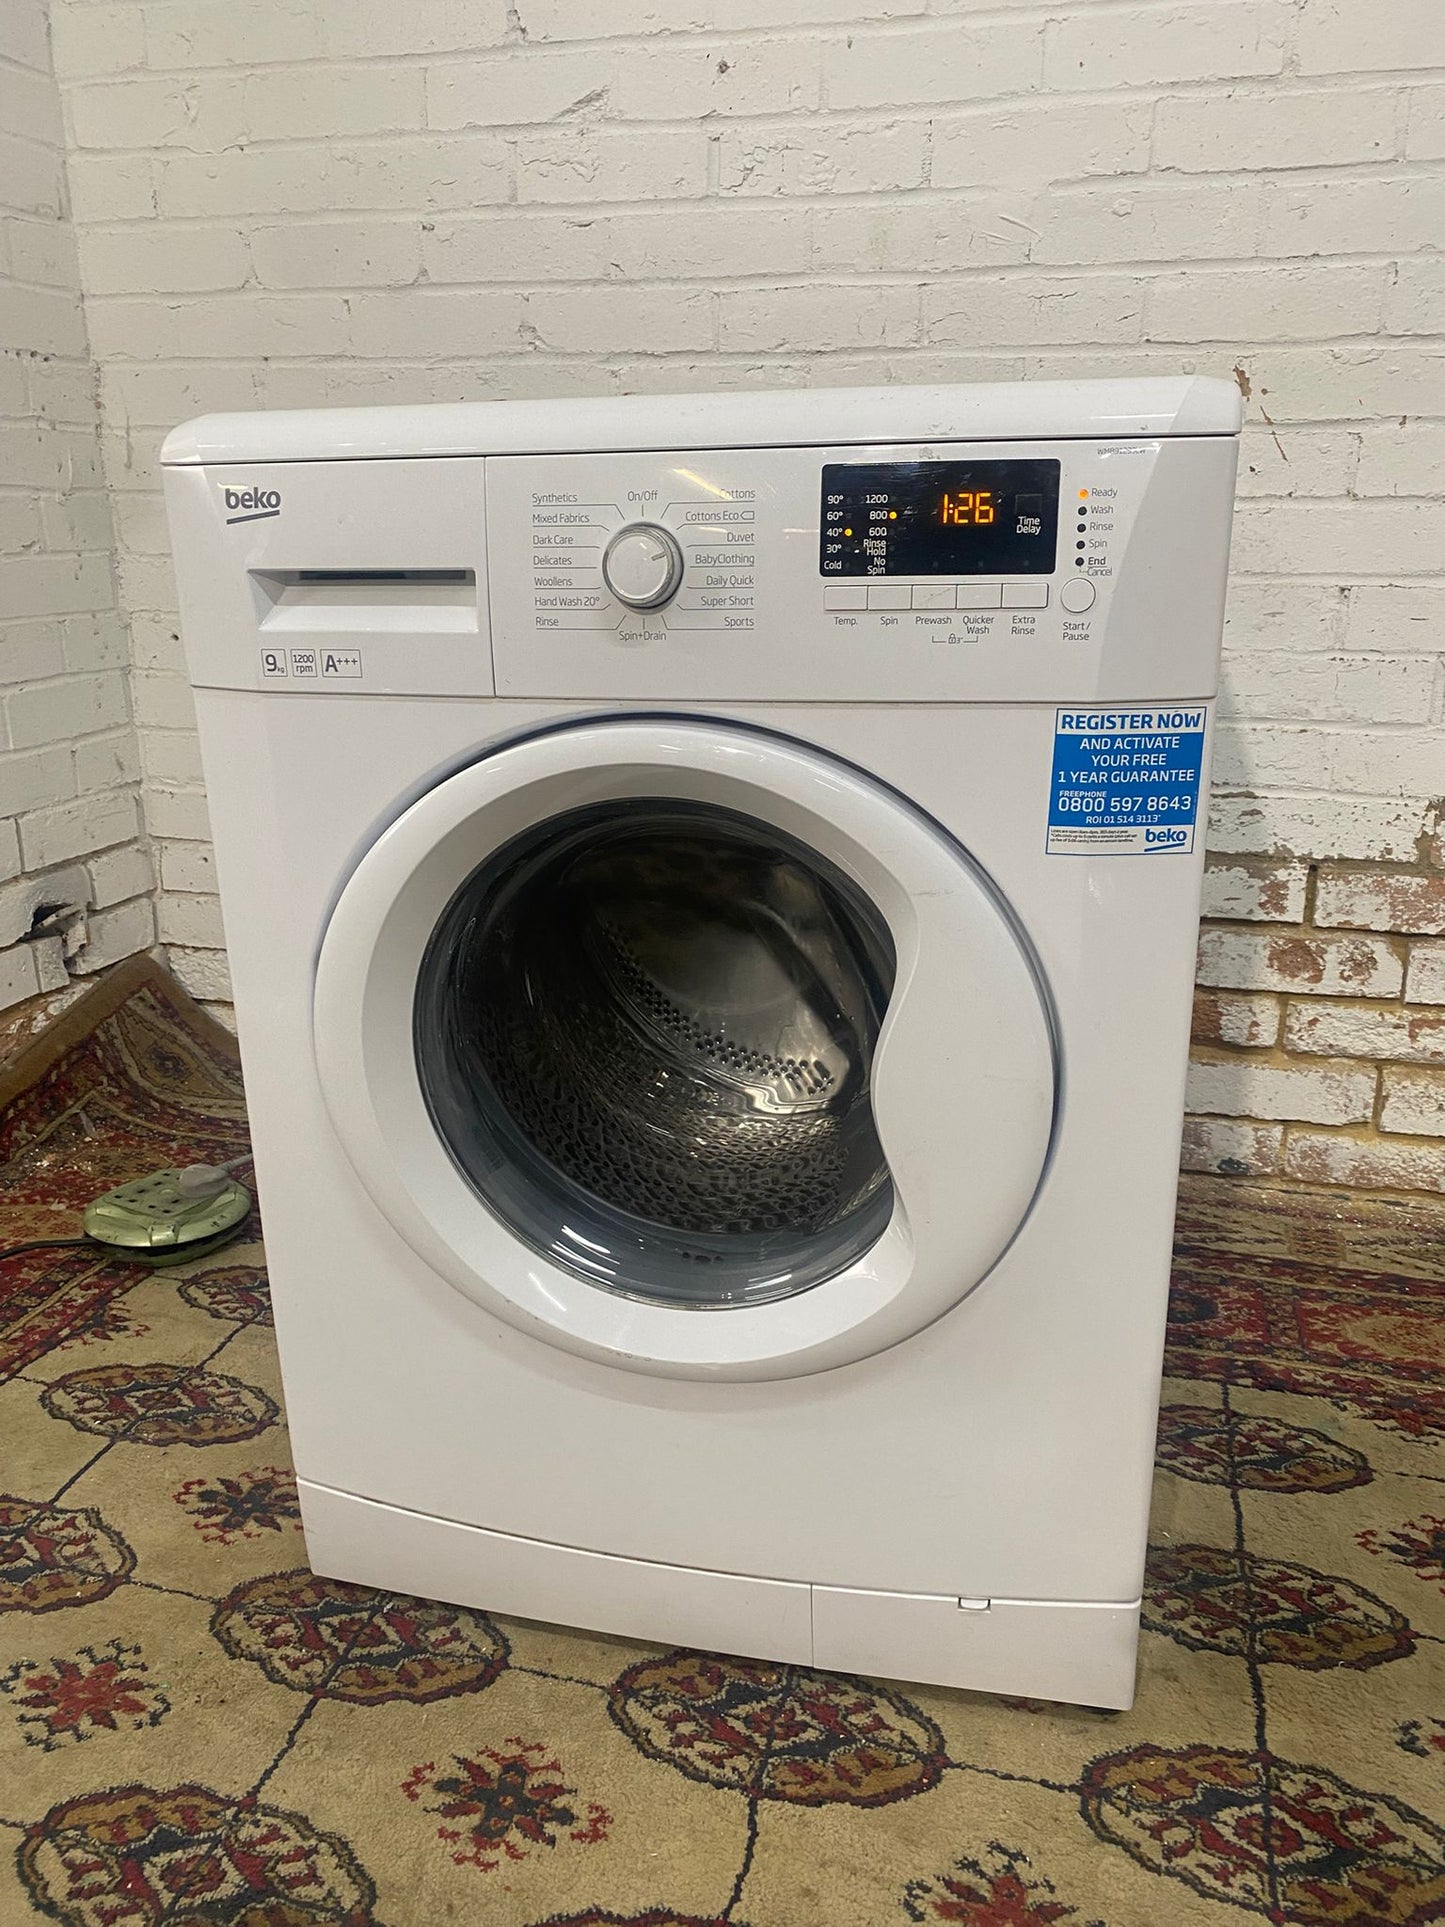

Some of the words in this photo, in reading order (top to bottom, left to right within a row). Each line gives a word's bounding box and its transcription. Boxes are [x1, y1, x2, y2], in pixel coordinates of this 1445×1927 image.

[225, 487, 281, 509] beko
[532, 492, 578, 503] Synthetics
[627, 490, 659, 501] On/Off
[1091, 488, 1118, 498] Ready
[865, 494, 888, 503] 1200
[942, 492, 994, 524] 1:26
[1090, 505, 1113, 514] Wash
[532, 513, 558, 524] Mixed
[559, 513, 590, 524] Fabrics
[685, 511, 721, 521] Cottons
[723, 511, 739, 520] Eco
[869, 511, 888, 520] 800
[1018, 516, 1040, 525] Time
[869, 527, 887, 536] 600
[1016, 524, 1041, 535] Delay
[1089, 522, 1113, 531] Rinse
[532, 535, 552, 545] Dark
[554, 535, 574, 545] Care
[727, 532, 755, 542] Duvet
[863, 538, 887, 547] Rinse
[1088, 539, 1107, 549] Spin
[866, 547, 887, 556] Hold
[533, 555, 572, 566] Delicates
[695, 554, 755, 566] BabyClothing
[824, 560, 842, 570] Cold
[873, 557, 886, 566] No
[1088, 557, 1106, 565] End
[867, 565, 886, 575] Spin
[1087, 567, 1112, 576] Cancel
[534, 576, 573, 587] Woollens
[706, 575, 728, 586] Daily
[730, 575, 754, 586] Quick
[534, 597, 559, 606] Hand
[560, 597, 582, 606] Wash
[701, 596, 728, 607] Super
[729, 595, 754, 606] Short
[535, 617, 559, 627] Rinse
[724, 617, 754, 628] Sports
[834, 616, 858, 626] Temp.
[880, 616, 898, 626] Spin
[915, 616, 952, 625] Prewash
[962, 615, 995, 625] Quicker
[1012, 615, 1036, 624] Extra
[966, 626, 990, 634] Wash
[1011, 625, 1035, 635] Rinse
[619, 631, 667, 642] Spin+Drain
[1062, 633, 1090, 641] Pause
[293, 654, 314, 663] 1200
[325, 655, 358, 672] A+++
[296, 665, 313, 674] rpm
[1061, 713, 1153, 730] REGISTER
[1157, 712, 1202, 729] NOW
[1080, 738, 1111, 750] AND
[1113, 736, 1181, 749] ACTIVATE
[1091, 755, 1130, 767] YOUR
[1132, 754, 1167, 766] FREE
[1058, 771, 1066, 783] 1
[1070, 771, 1108, 783] YEAR
[1111, 769, 1195, 783] GUARANTEE
[1059, 790, 1108, 798] FREEPHONE
[1058, 797, 1105, 812] 0800
[1110, 797, 1143, 812] 597
[1147, 796, 1192, 811] 8643
[1086, 816, 1102, 824] ROI
[1103, 816, 1115, 824] 01
[1117, 815, 1134, 823] 514
[1145, 828, 1187, 843] beko
